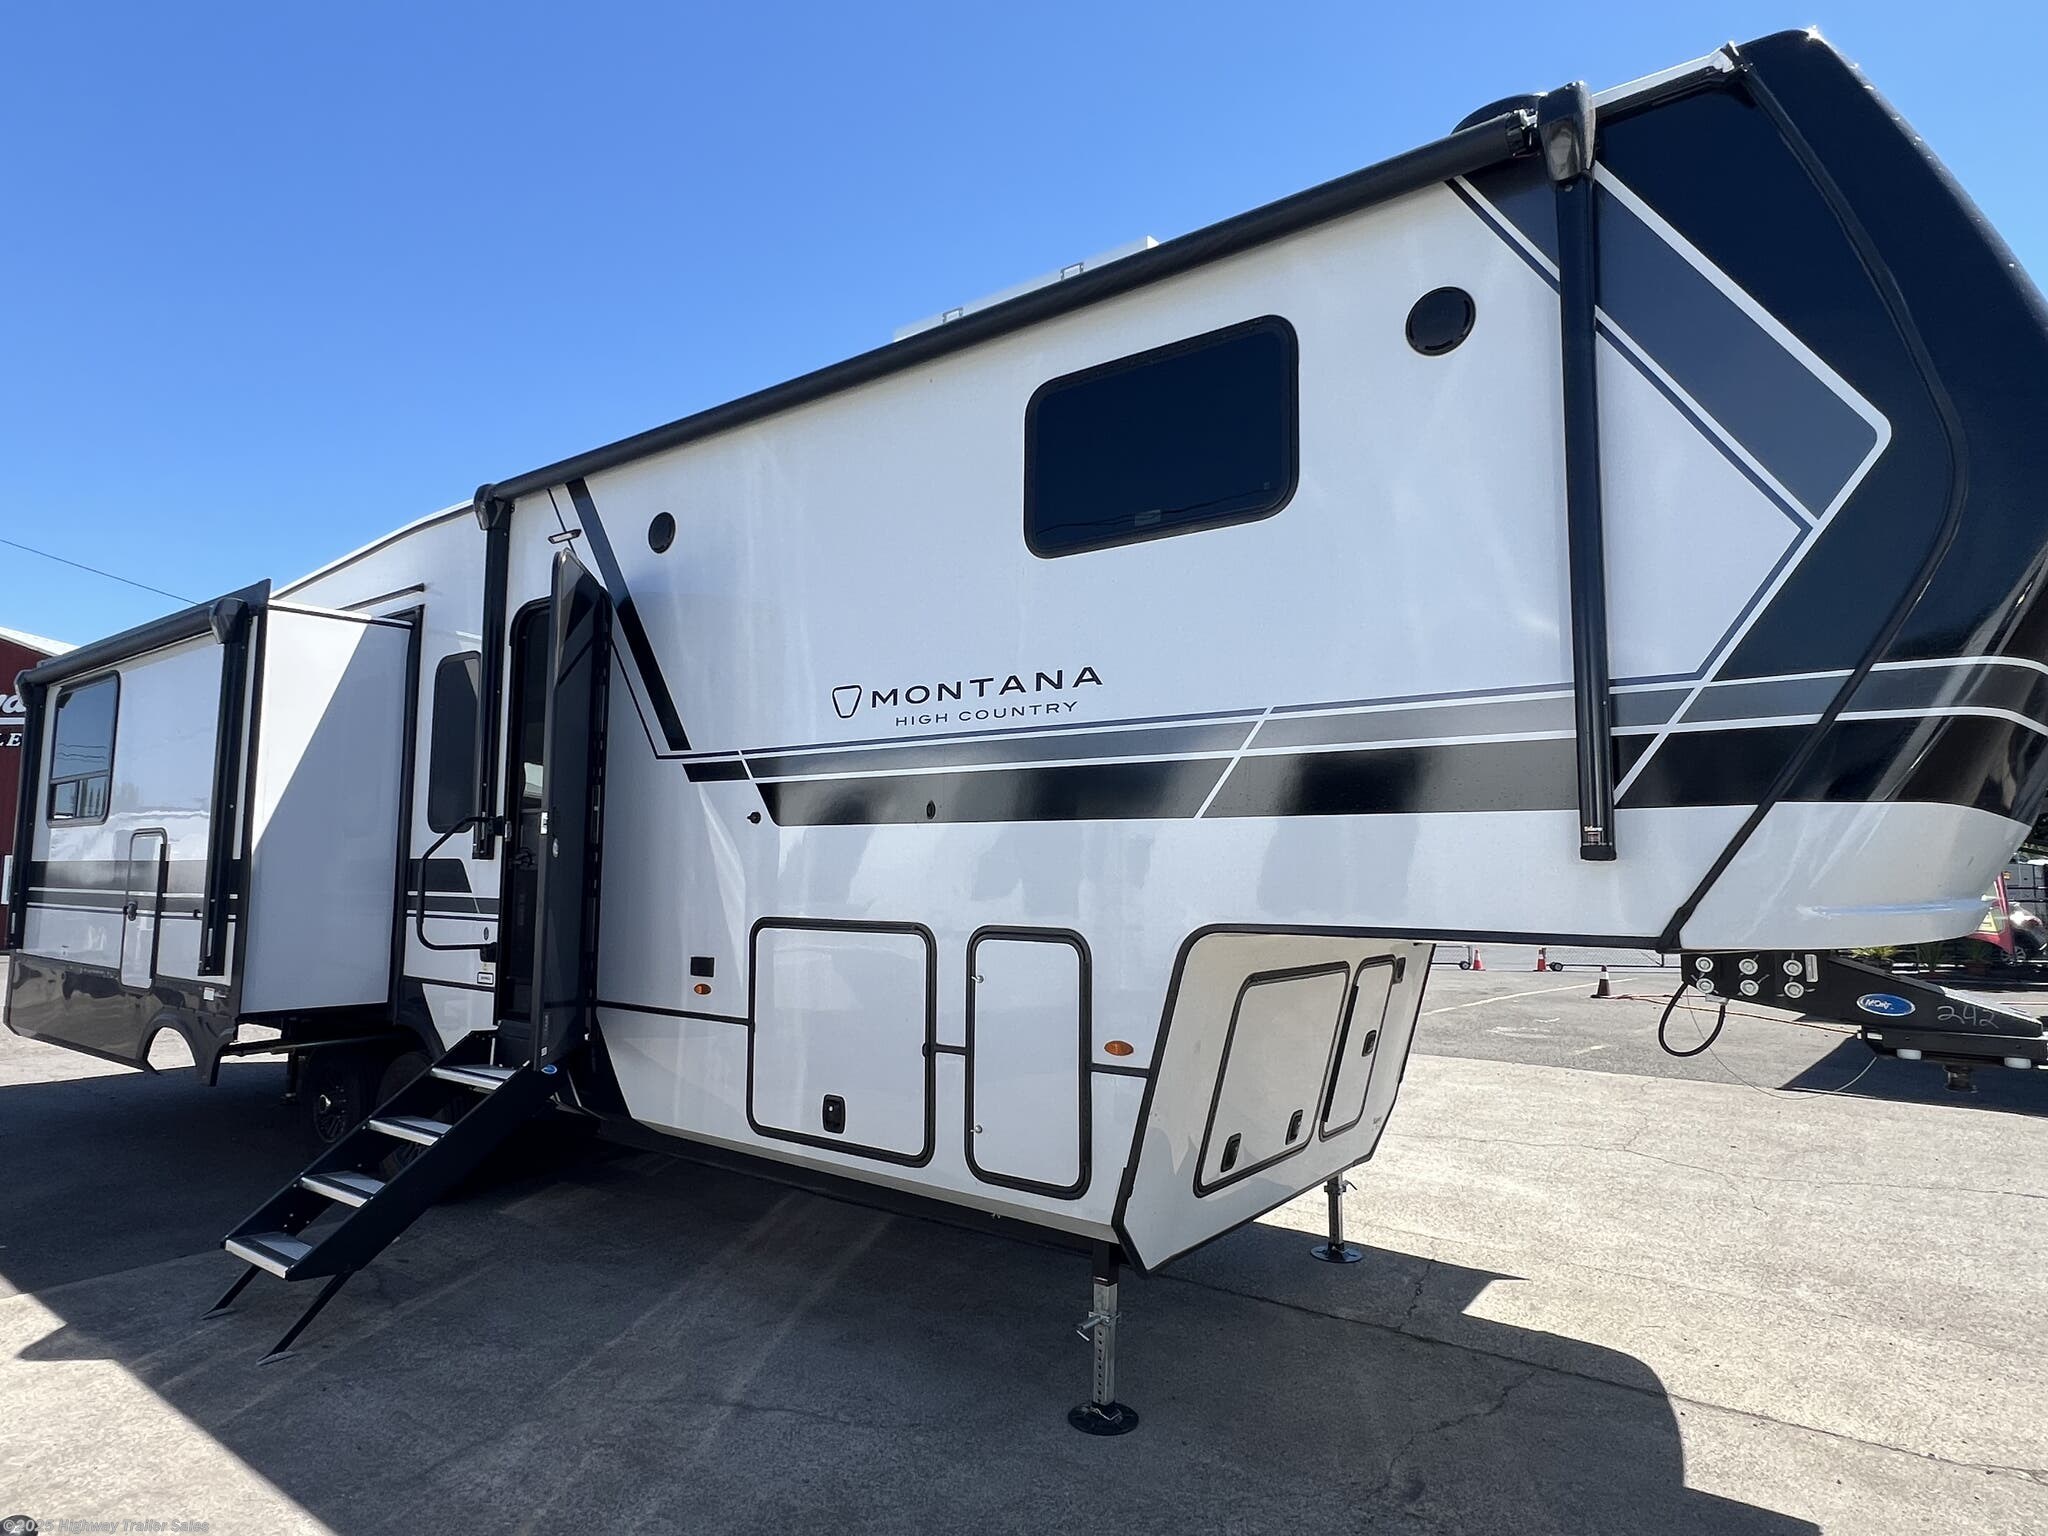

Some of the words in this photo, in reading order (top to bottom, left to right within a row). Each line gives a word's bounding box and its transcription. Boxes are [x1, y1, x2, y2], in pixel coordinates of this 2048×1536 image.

[871, 666, 1103, 709] MONTANA
[895, 712, 948, 727] HIGH
[959, 701, 1078, 722] COUNTRY
